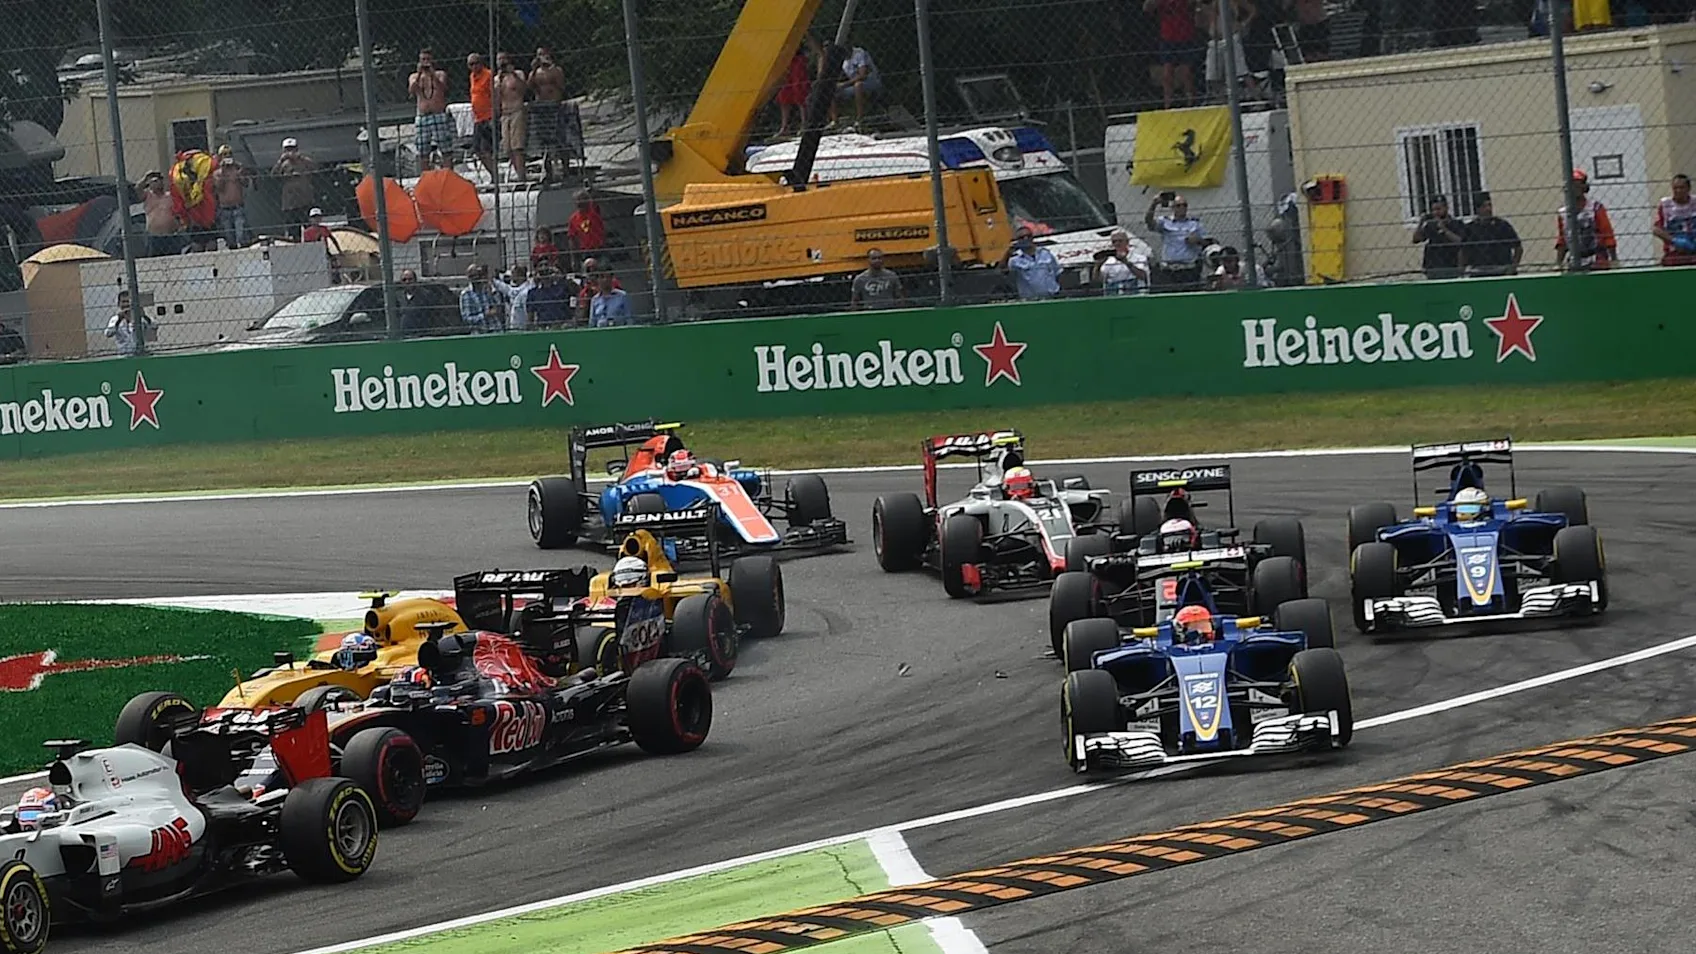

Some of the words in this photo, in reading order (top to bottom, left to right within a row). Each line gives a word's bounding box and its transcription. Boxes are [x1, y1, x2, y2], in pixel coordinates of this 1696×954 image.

[673, 208, 765, 227] NACANCO
[1242, 314, 1473, 367] Heineken
[331, 363, 522, 412] Heineken
[755, 341, 963, 391] Heineken
[1190, 696, 1217, 709] 12
